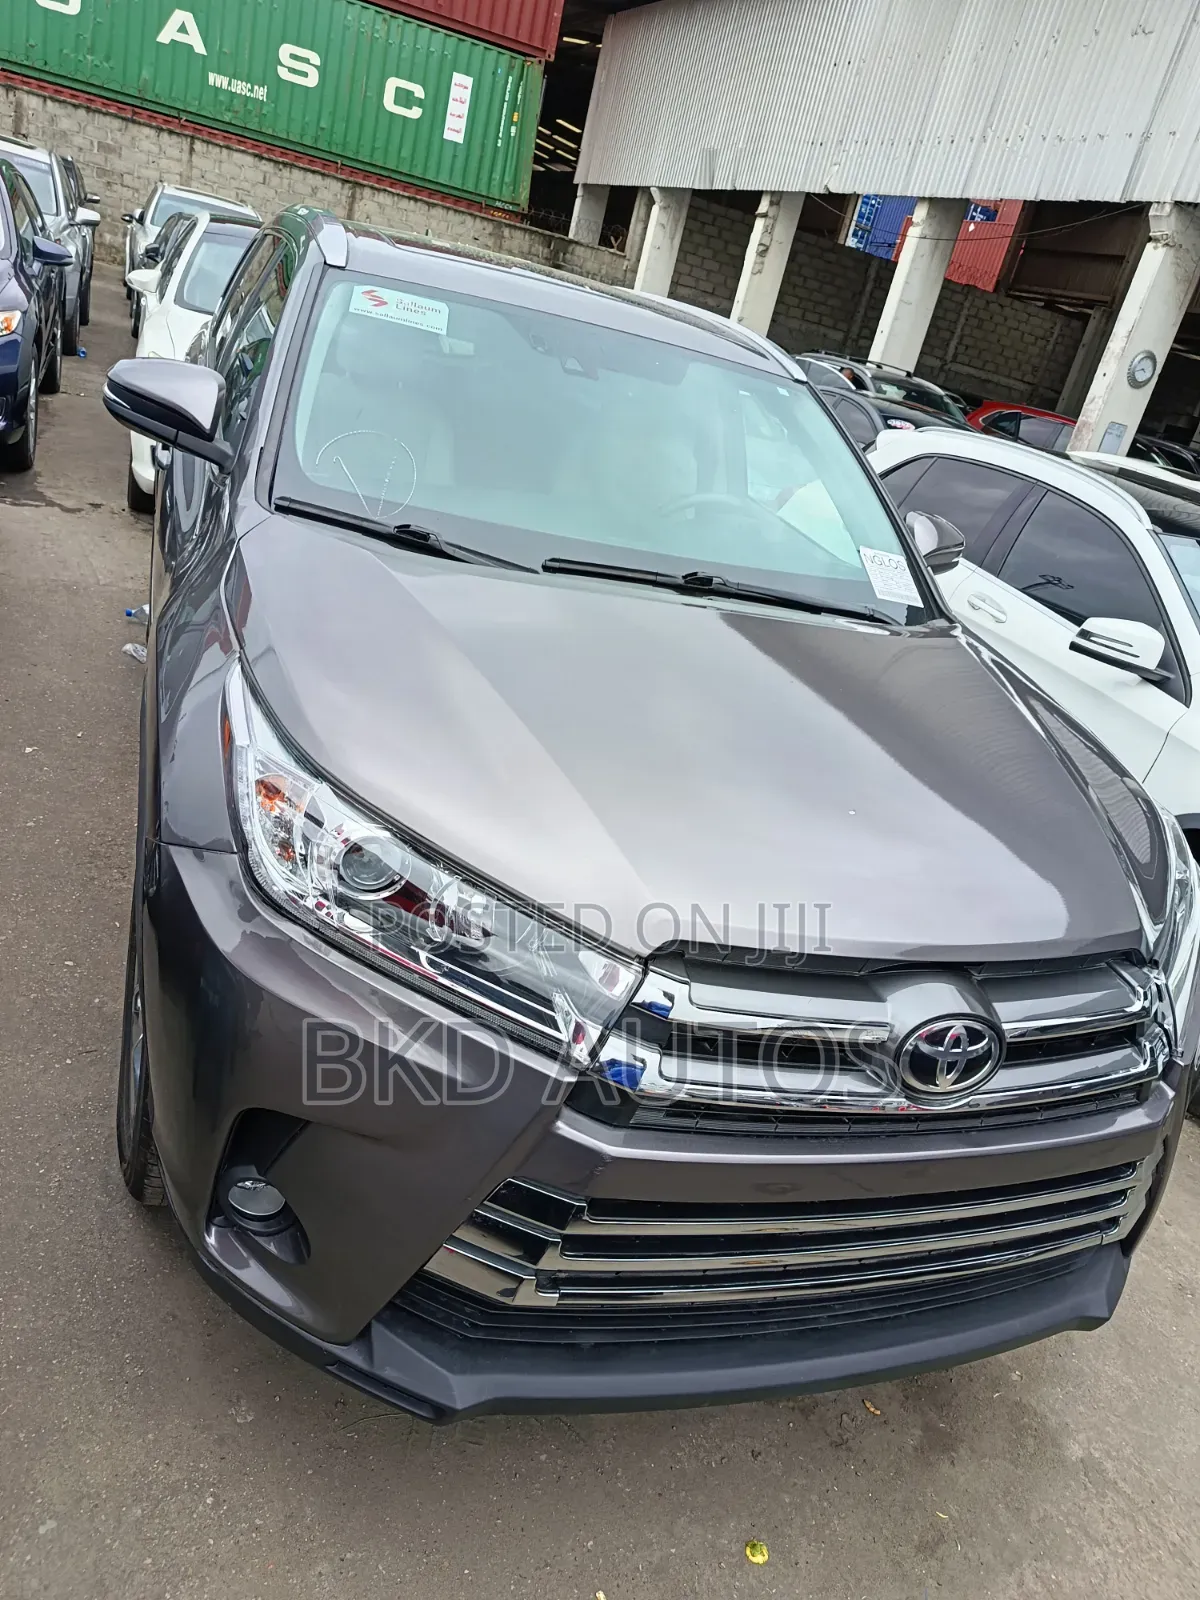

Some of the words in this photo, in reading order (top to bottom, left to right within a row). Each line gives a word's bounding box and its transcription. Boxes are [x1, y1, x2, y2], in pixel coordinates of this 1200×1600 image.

[35, 0, 425, 120] ASC
[208, 71, 268, 102] www.uasc.net
[395, 303, 427, 316] Lines
[863, 553, 906, 572] NGLOS
